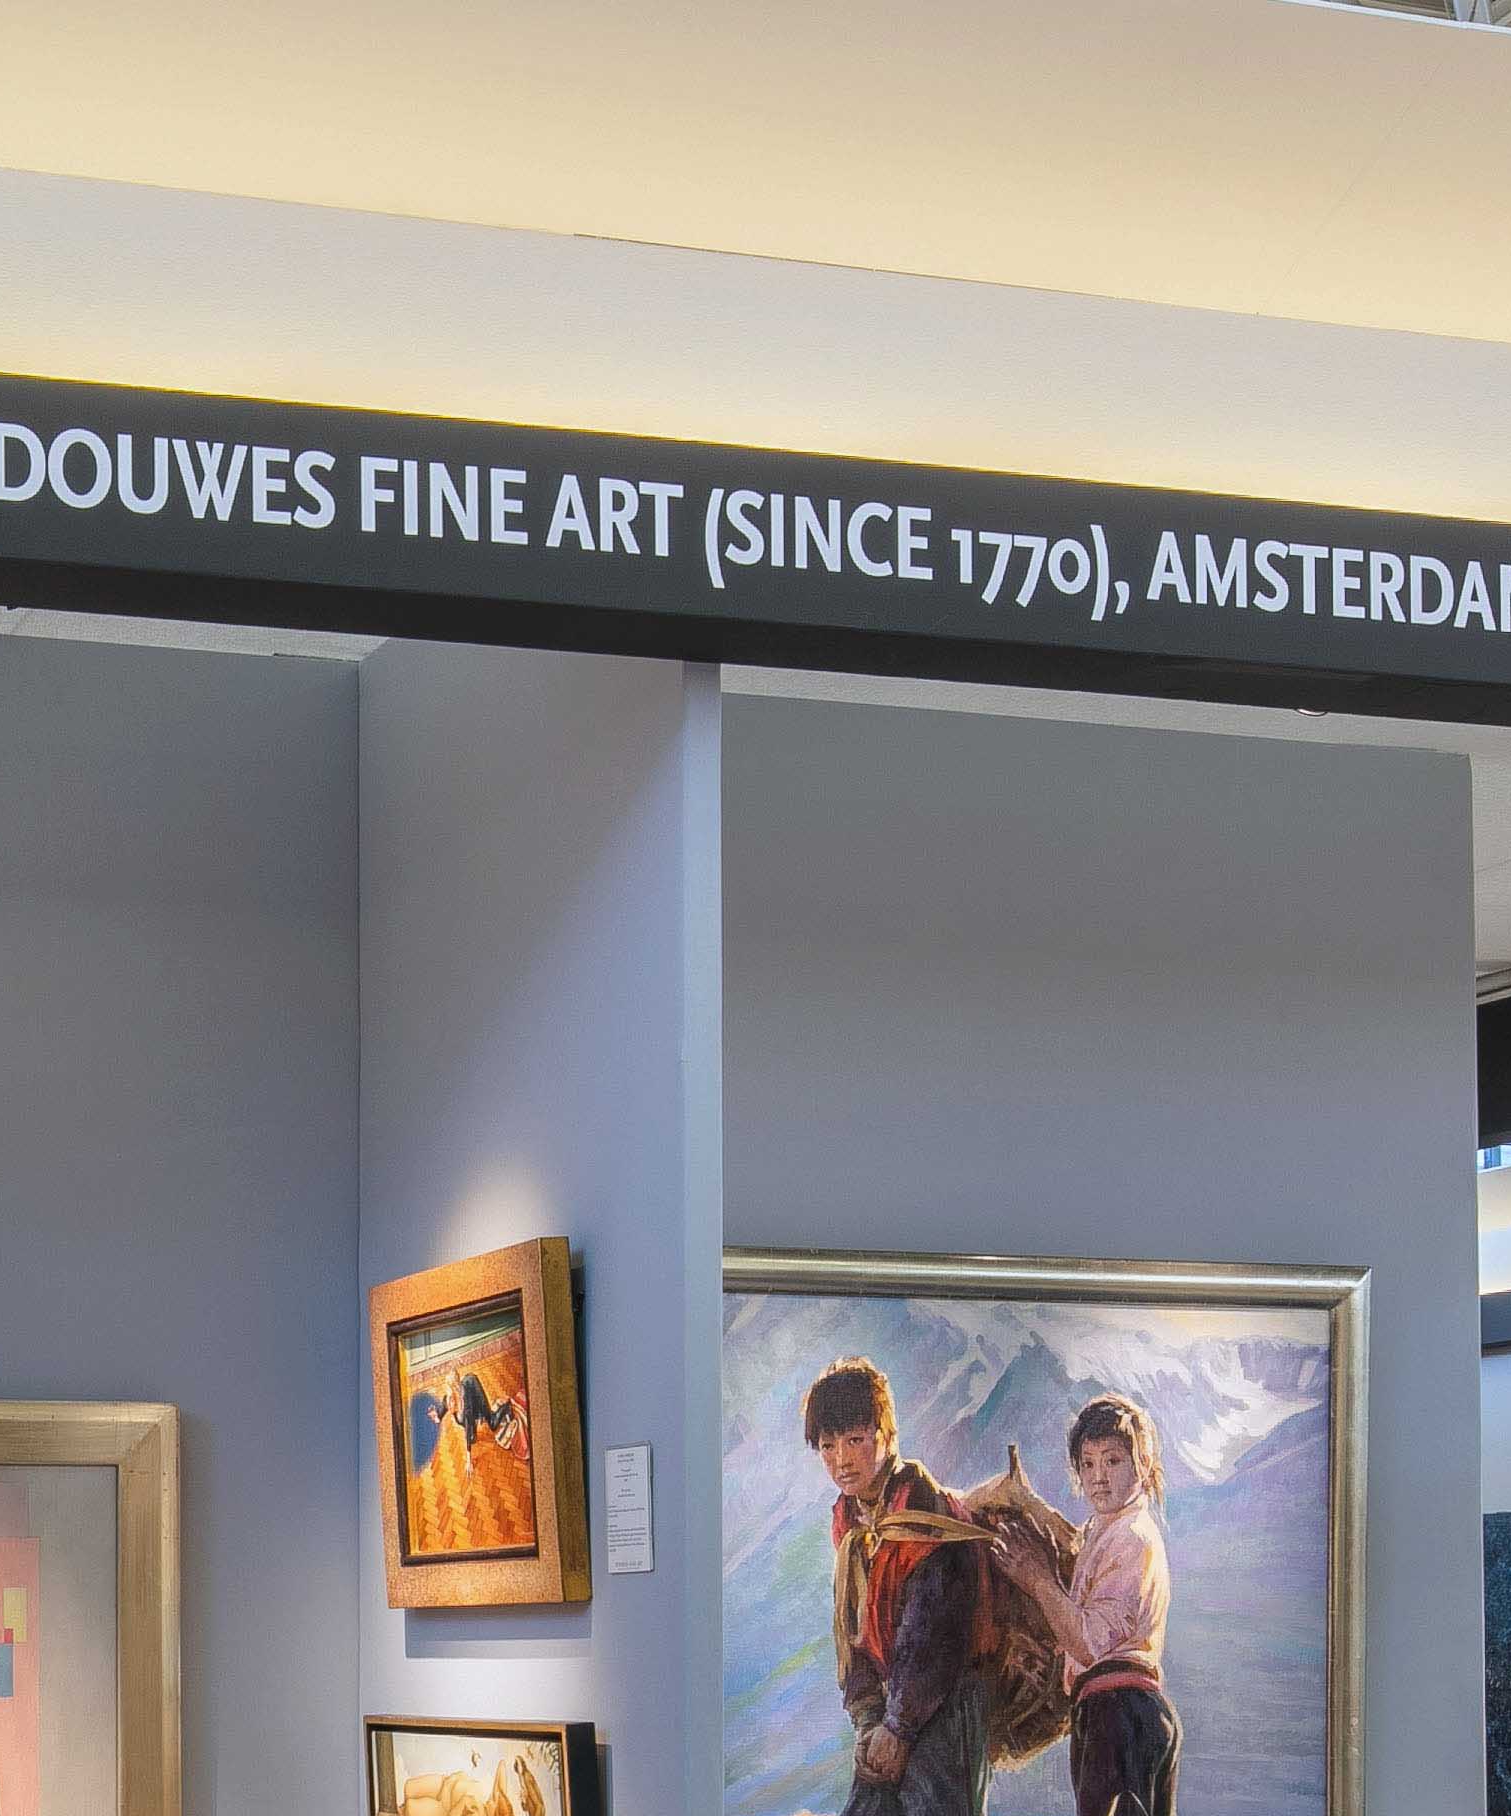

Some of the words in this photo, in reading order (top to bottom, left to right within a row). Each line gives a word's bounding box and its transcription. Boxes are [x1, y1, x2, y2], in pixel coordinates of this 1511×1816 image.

[360, 455, 529, 545] FINE
[545, 474, 684, 557] ART
[705, 488, 933, 589] (SINCE
[951, 524, 1130, 622] 1770),
